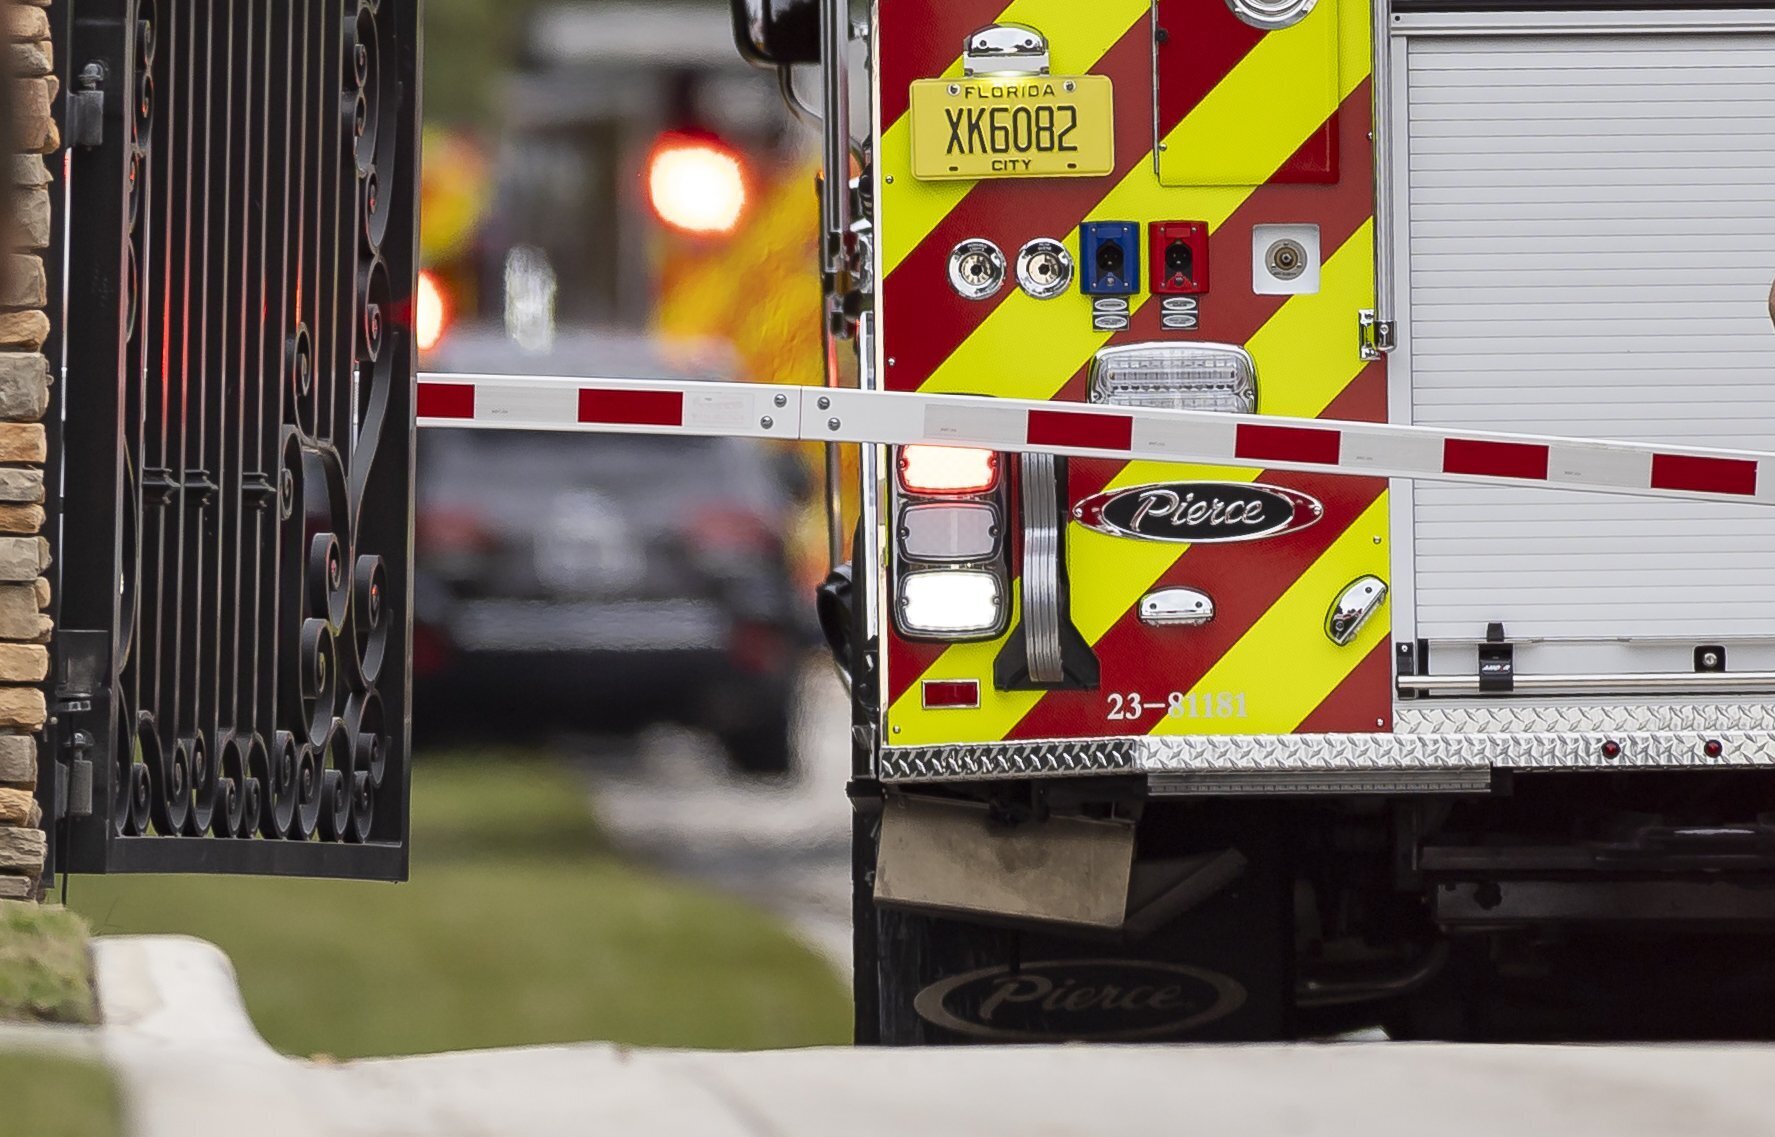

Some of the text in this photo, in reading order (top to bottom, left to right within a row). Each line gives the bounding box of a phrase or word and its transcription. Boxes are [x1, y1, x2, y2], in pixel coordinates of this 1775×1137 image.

[964, 84, 1056, 99] FLORIDA
[944, 105, 1078, 154] XK6082
[991, 159, 1032, 172] CITY
[1129, 489, 1266, 532] Pierce
[1106, 691, 1249, 720] 23-81181
[979, 973, 1184, 1021] Pierce
